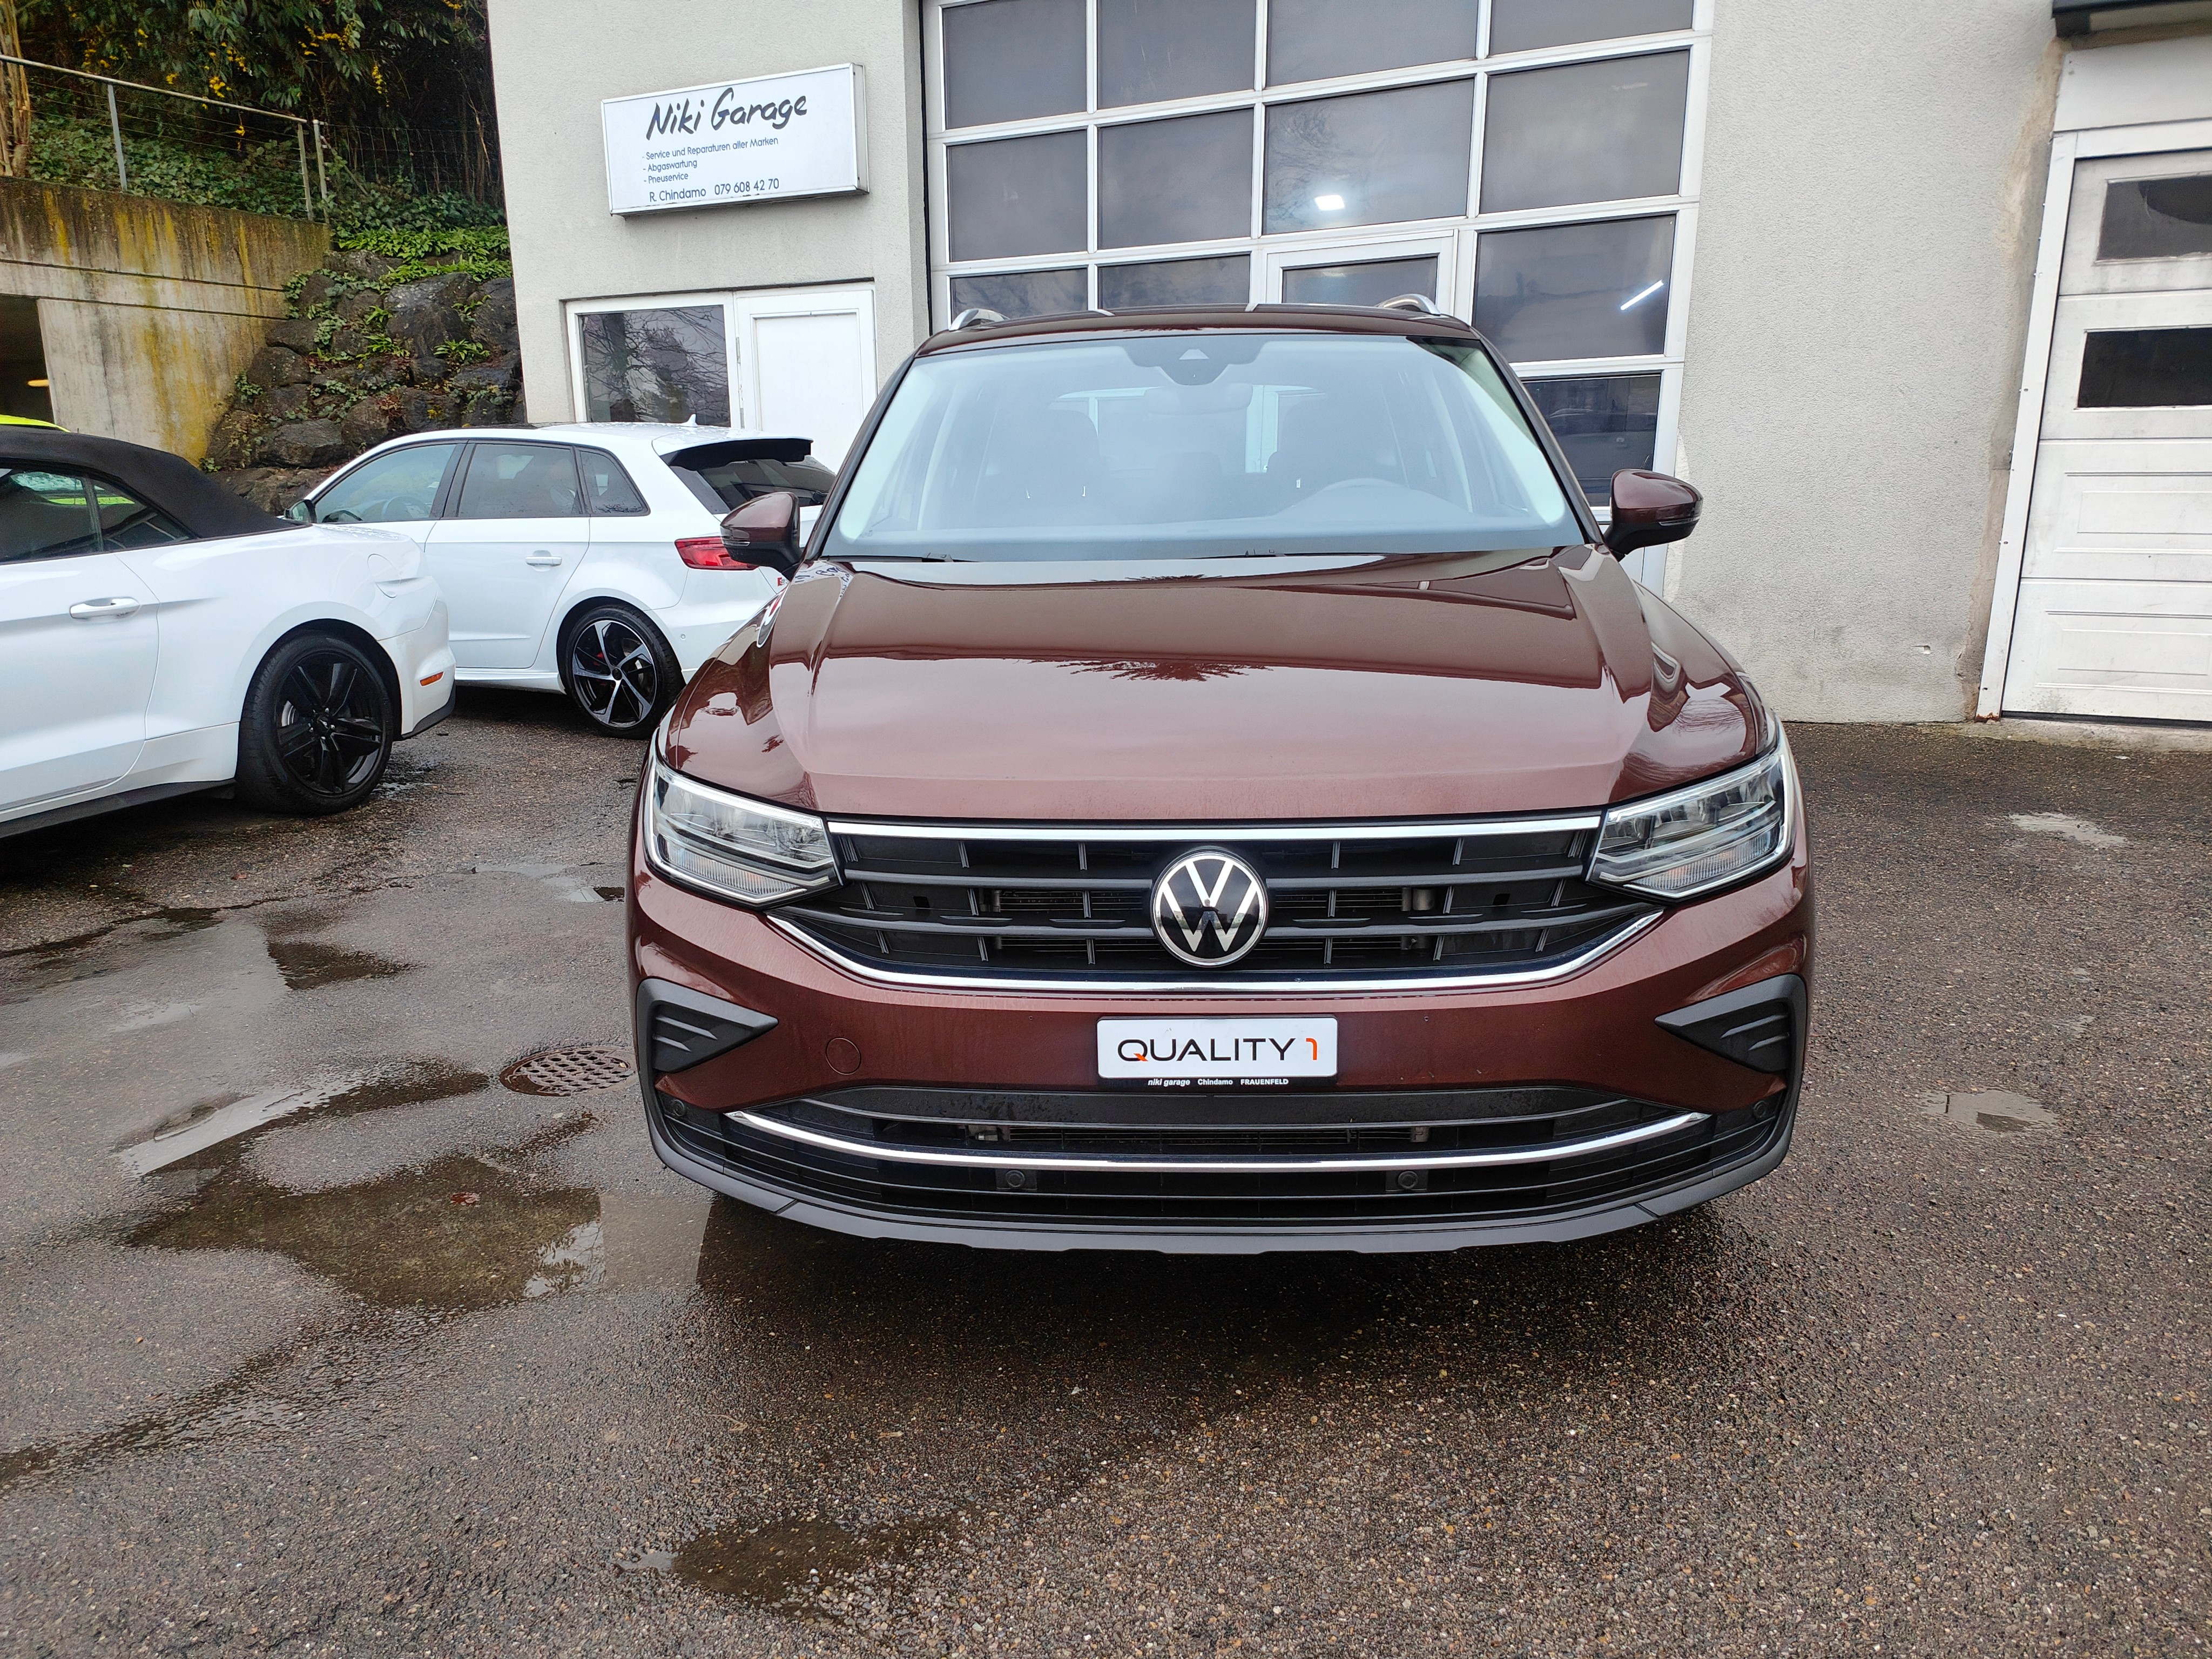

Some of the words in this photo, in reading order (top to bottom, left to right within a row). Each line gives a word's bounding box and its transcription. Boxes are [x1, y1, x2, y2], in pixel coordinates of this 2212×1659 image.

[646, 98, 705, 140] Niki
[711, 87, 807, 130] Garage
[646, 150, 670, 160] Service
[672, 147, 685, 157] und
[687, 143, 731, 156] Reparaturen
[732, 140, 748, 150] aller
[750, 137, 779, 148] Marken
[648, 159, 697, 172] Abgaswartung
[648, 172, 689, 184] Pneuservice
[649, 192, 657, 202] R.
[659, 188, 706, 201] Chindamo
[714, 184, 731, 195] 079
[733, 181, 750, 193] 608
[753, 179, 765, 191] 42
[768, 178, 779, 190] 70
[1117, 1037, 1297, 1062] QUALITY
